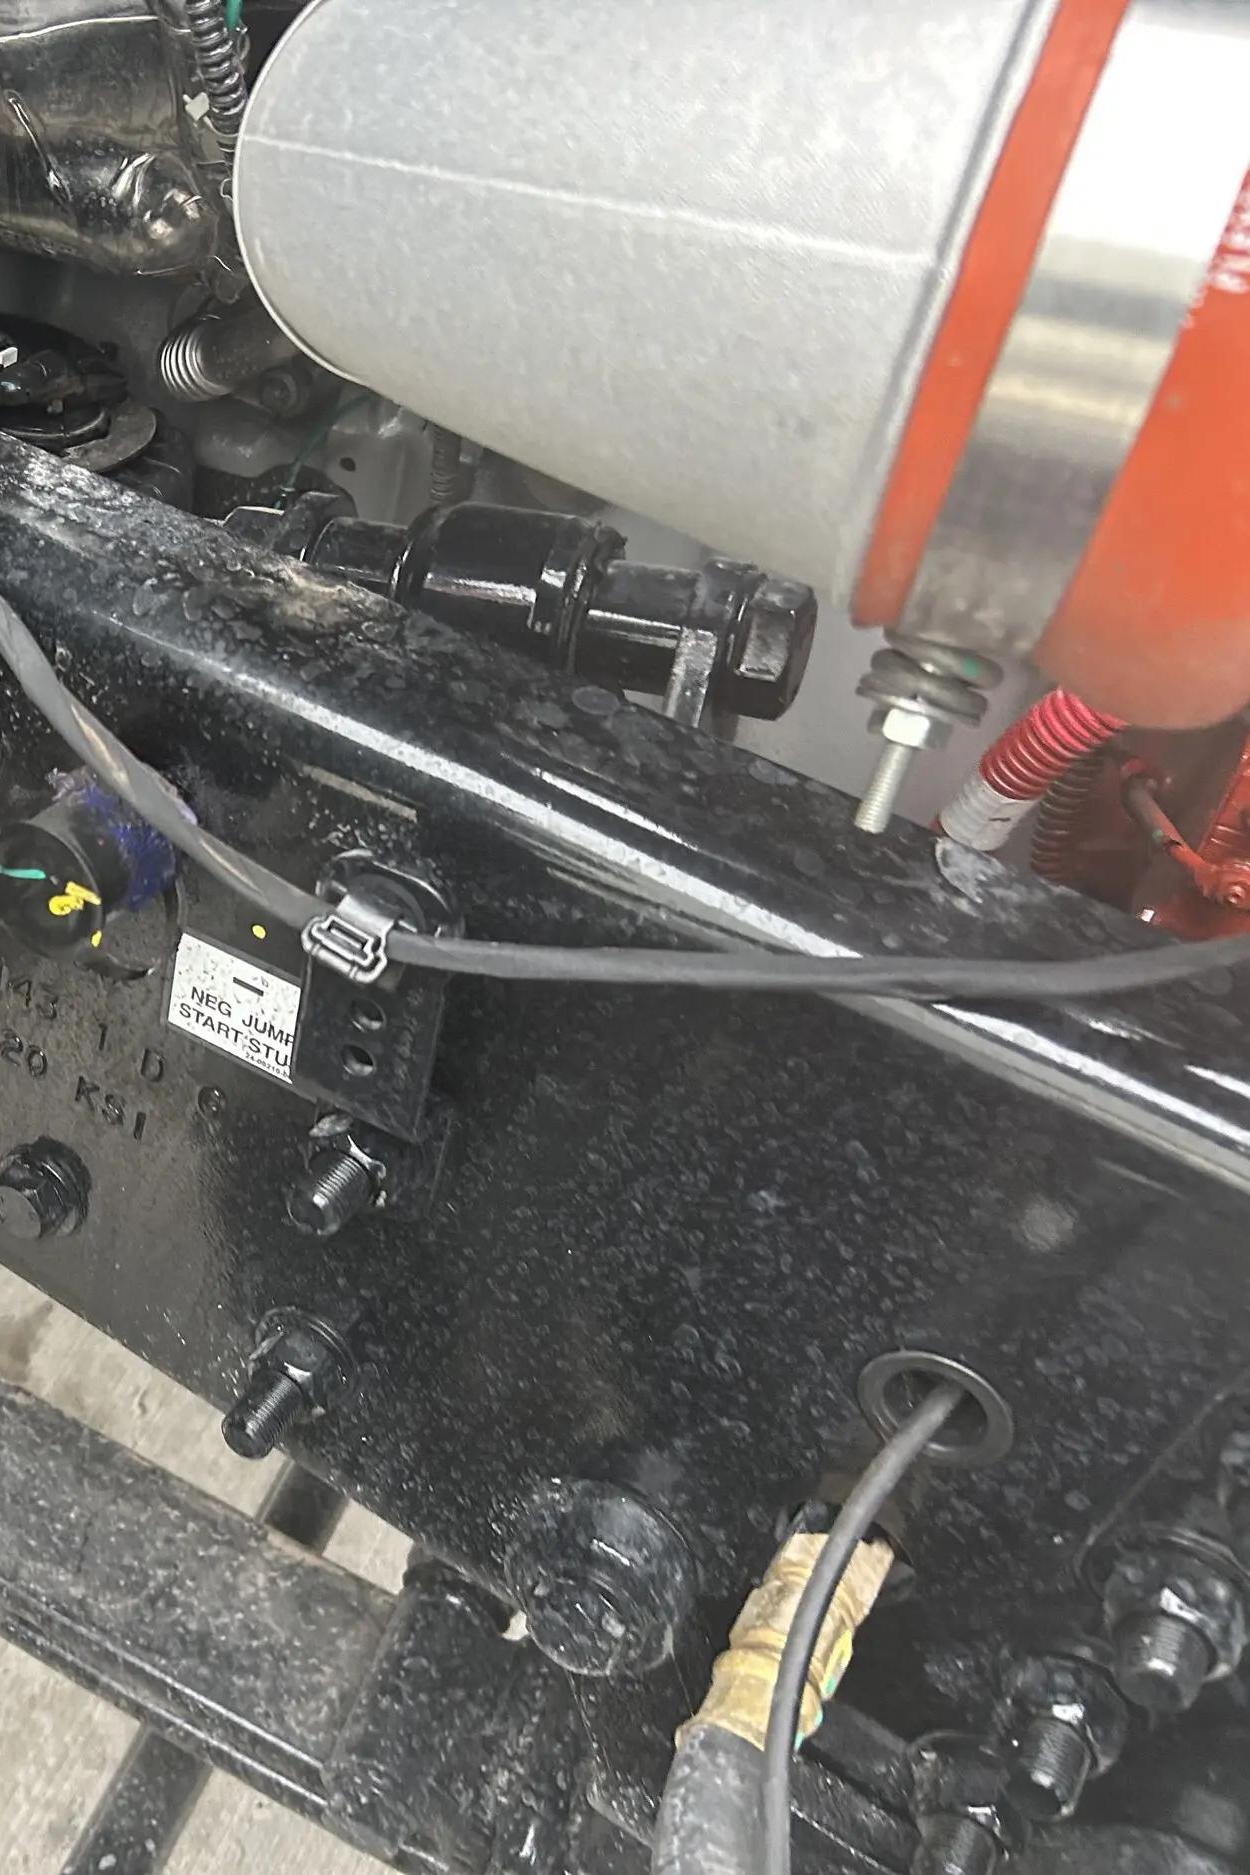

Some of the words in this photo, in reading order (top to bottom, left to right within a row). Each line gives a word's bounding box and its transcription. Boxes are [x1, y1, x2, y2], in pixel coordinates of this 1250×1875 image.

[179, 1003, 243, 1043] START
[249, 1037, 291, 1067] STU
[191, 986, 232, 1018] NEG
[242, 1015, 294, 1047] JUMP
[74, 1075, 146, 1141] KSI
